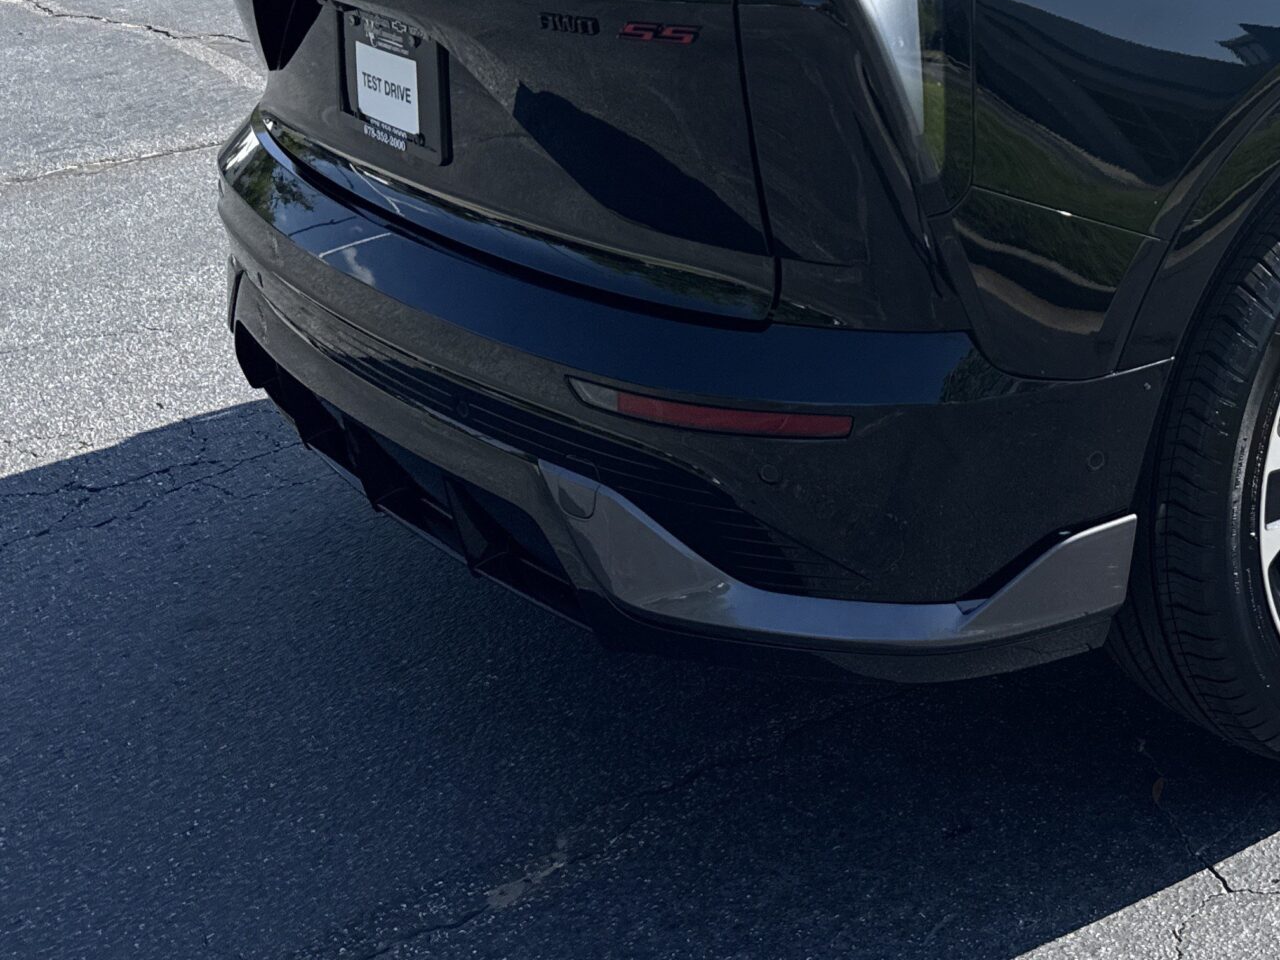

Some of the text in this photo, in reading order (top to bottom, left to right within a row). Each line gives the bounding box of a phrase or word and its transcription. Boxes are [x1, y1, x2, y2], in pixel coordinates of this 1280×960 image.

[616, 20, 703, 45] SS
[362, 72, 412, 104] TEST DRIVE
